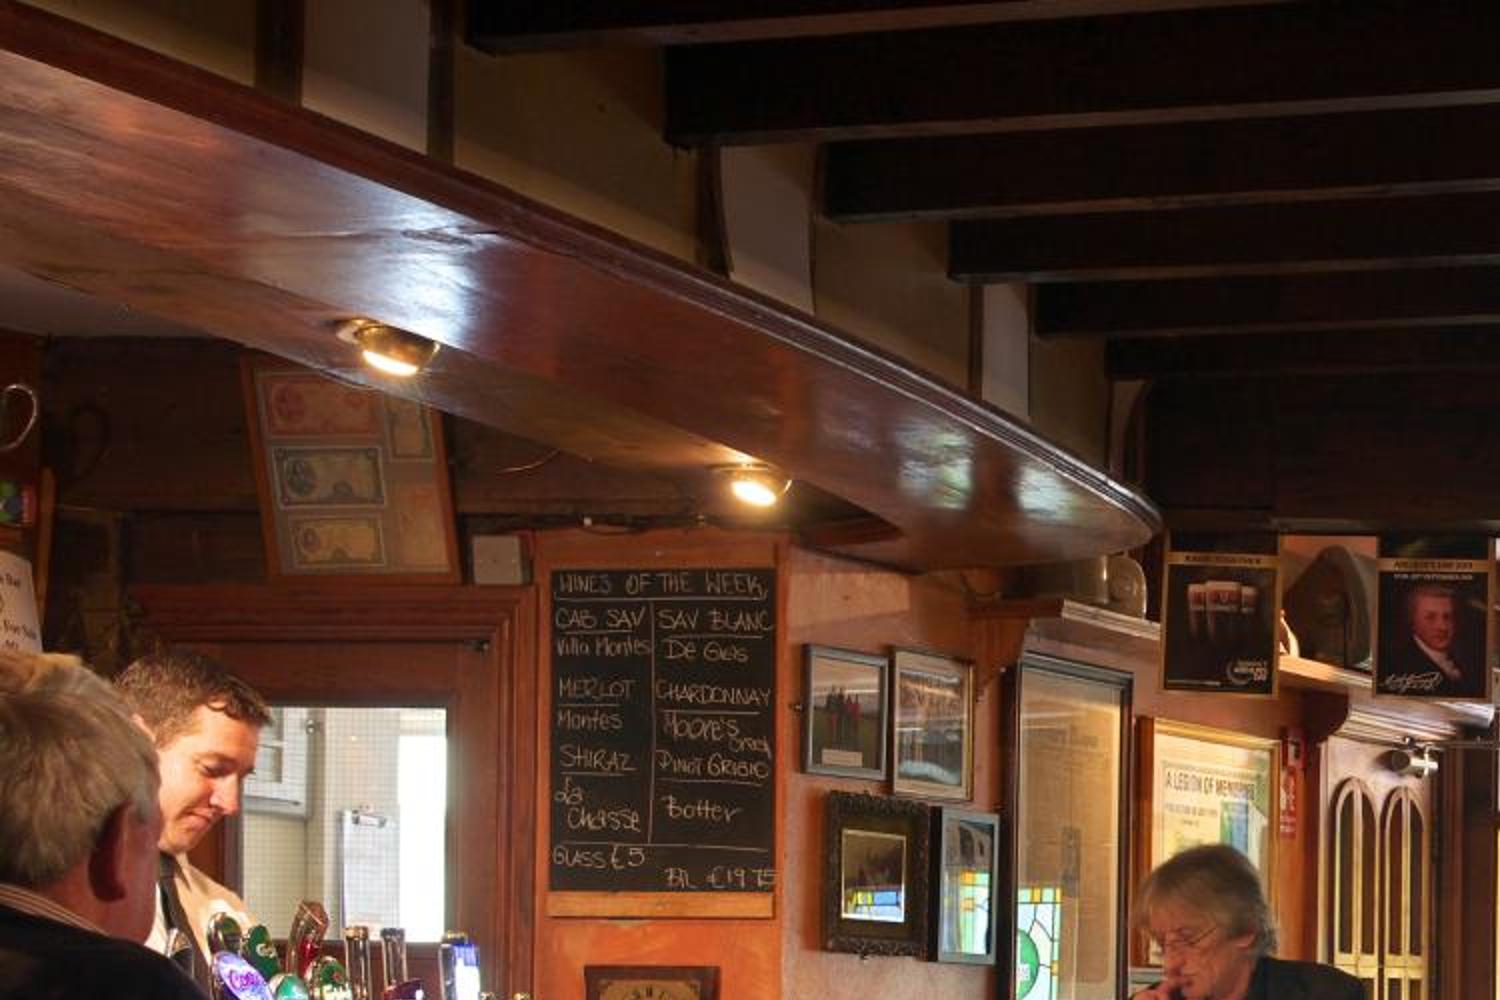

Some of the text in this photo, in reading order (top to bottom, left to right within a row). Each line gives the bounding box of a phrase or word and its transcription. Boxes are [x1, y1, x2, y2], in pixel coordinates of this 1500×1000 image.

[626, 573, 650, 594] OF
[656, 572, 690, 593] THE
[555, 606, 646, 629] CAB SAV
[658, 608, 774, 631] SAV BLANC
[559, 677, 635, 699] MERLOT
